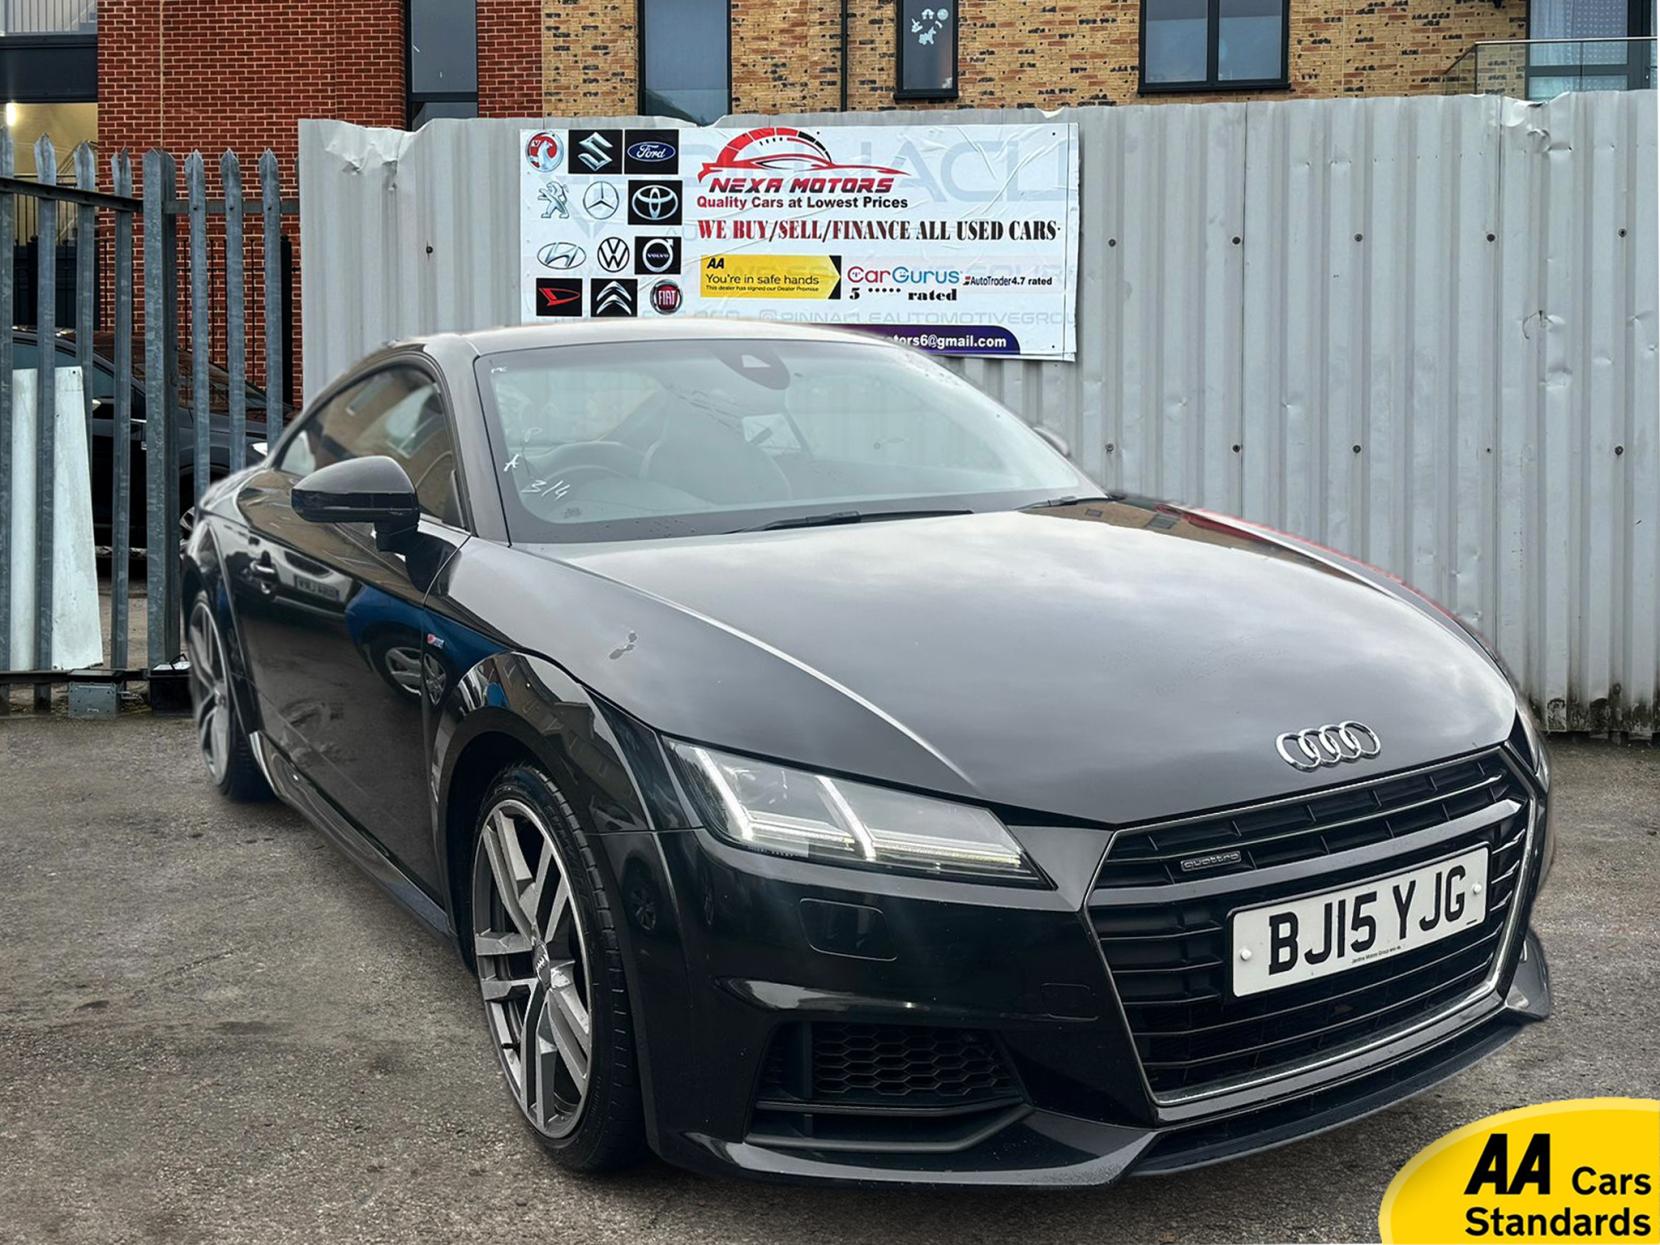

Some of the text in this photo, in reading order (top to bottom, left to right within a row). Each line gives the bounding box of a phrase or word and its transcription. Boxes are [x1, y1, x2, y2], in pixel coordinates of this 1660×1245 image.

[636, 144, 666, 158] Ford
[709, 177, 894, 193] NEXA MOTORS
[697, 196, 908, 210] Quality Cars at Lowest Prices
[697, 220, 727, 239] WE
[733, 220, 910, 242] BUY/SELL/FINANCE
[916, 220, 951, 240] ALL
[956, 220, 1003, 240] USED
[1008, 220, 1057, 240] CARS
[706, 257, 725, 269] AA
[705, 273, 820, 285] You're in safe hands
[847, 266, 960, 284] CarGurus
[1011, 276, 1026, 286] 4.7
[1028, 276, 1052, 286] rated
[658, 289, 677, 306] FIAT
[849, 287, 957, 301] 5 rated
[1183, 853, 1239, 868] quattro
[1268, 864, 1467, 976] BJ15 YJG
